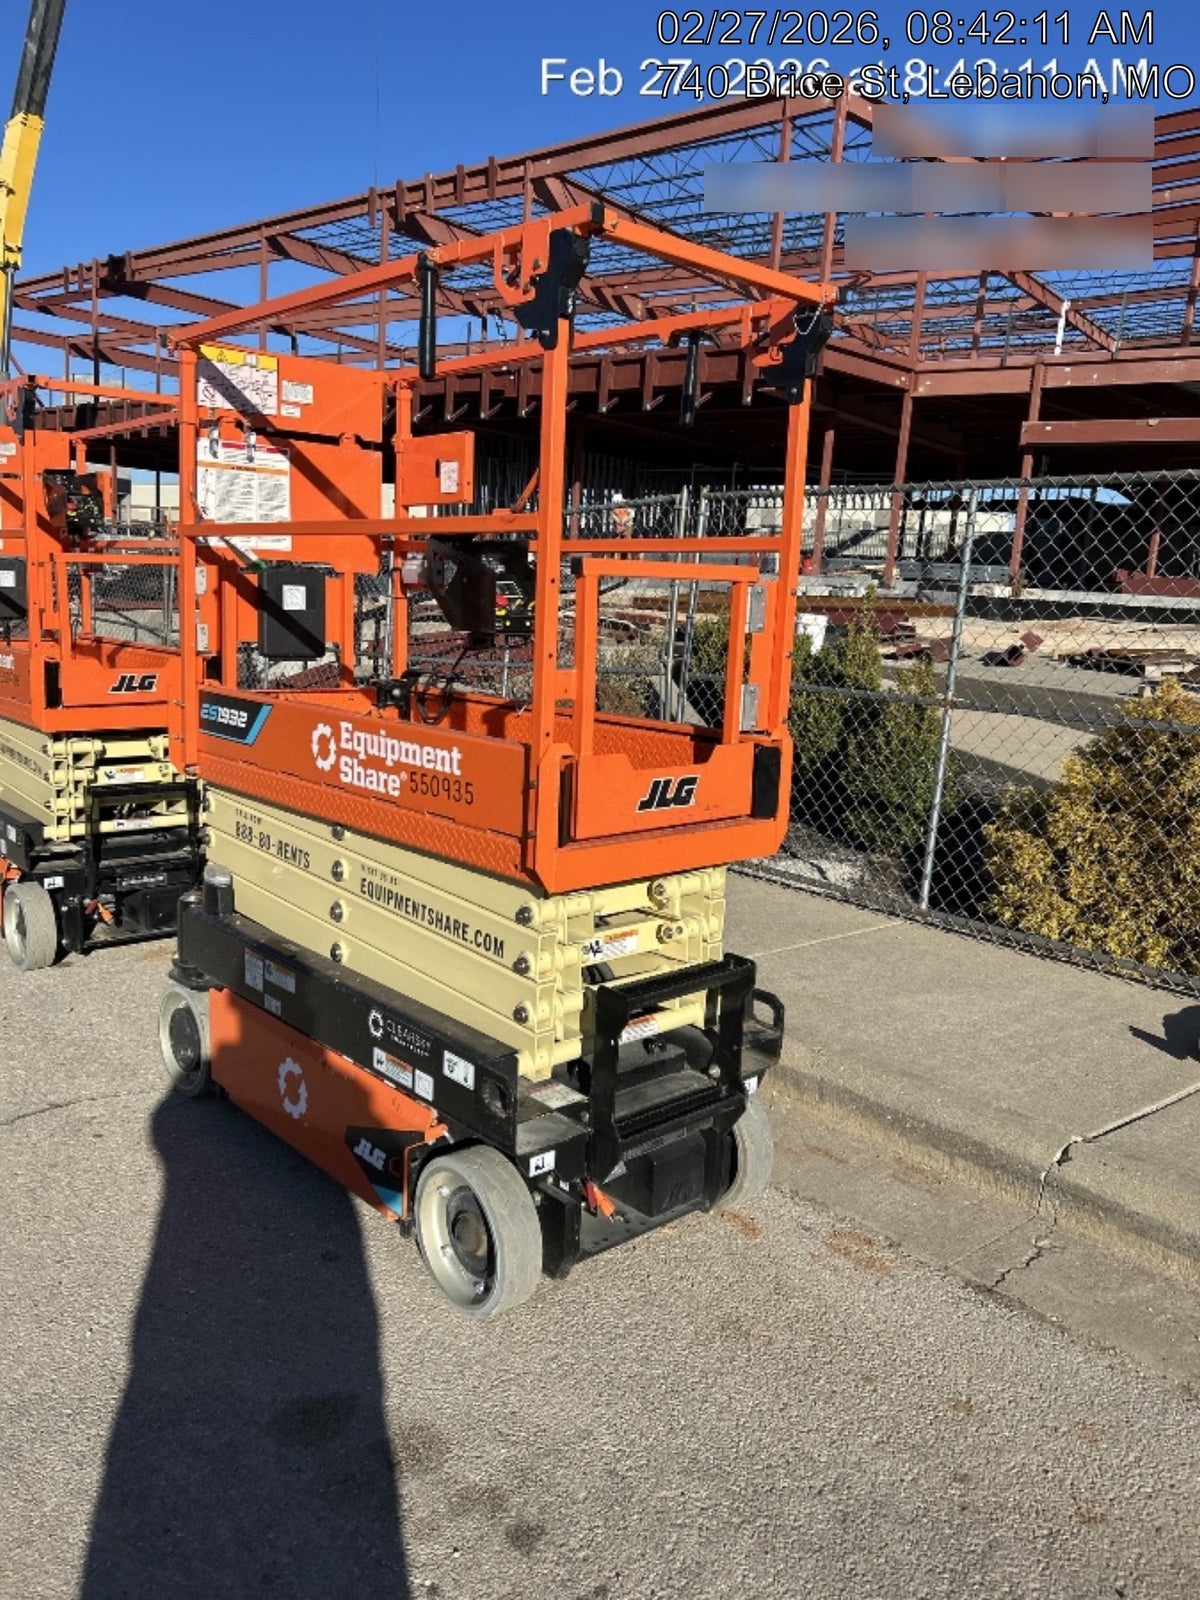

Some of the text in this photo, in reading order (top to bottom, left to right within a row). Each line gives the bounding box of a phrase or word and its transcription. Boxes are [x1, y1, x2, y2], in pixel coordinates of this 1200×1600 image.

[109, 674, 158, 693] JLG
[339, 721, 463, 776] Equipment
[409, 771, 475, 806] 550935
[638, 775, 698, 811] JLG
[360, 877, 505, 959] EQUIPMENTSHARE.COM
